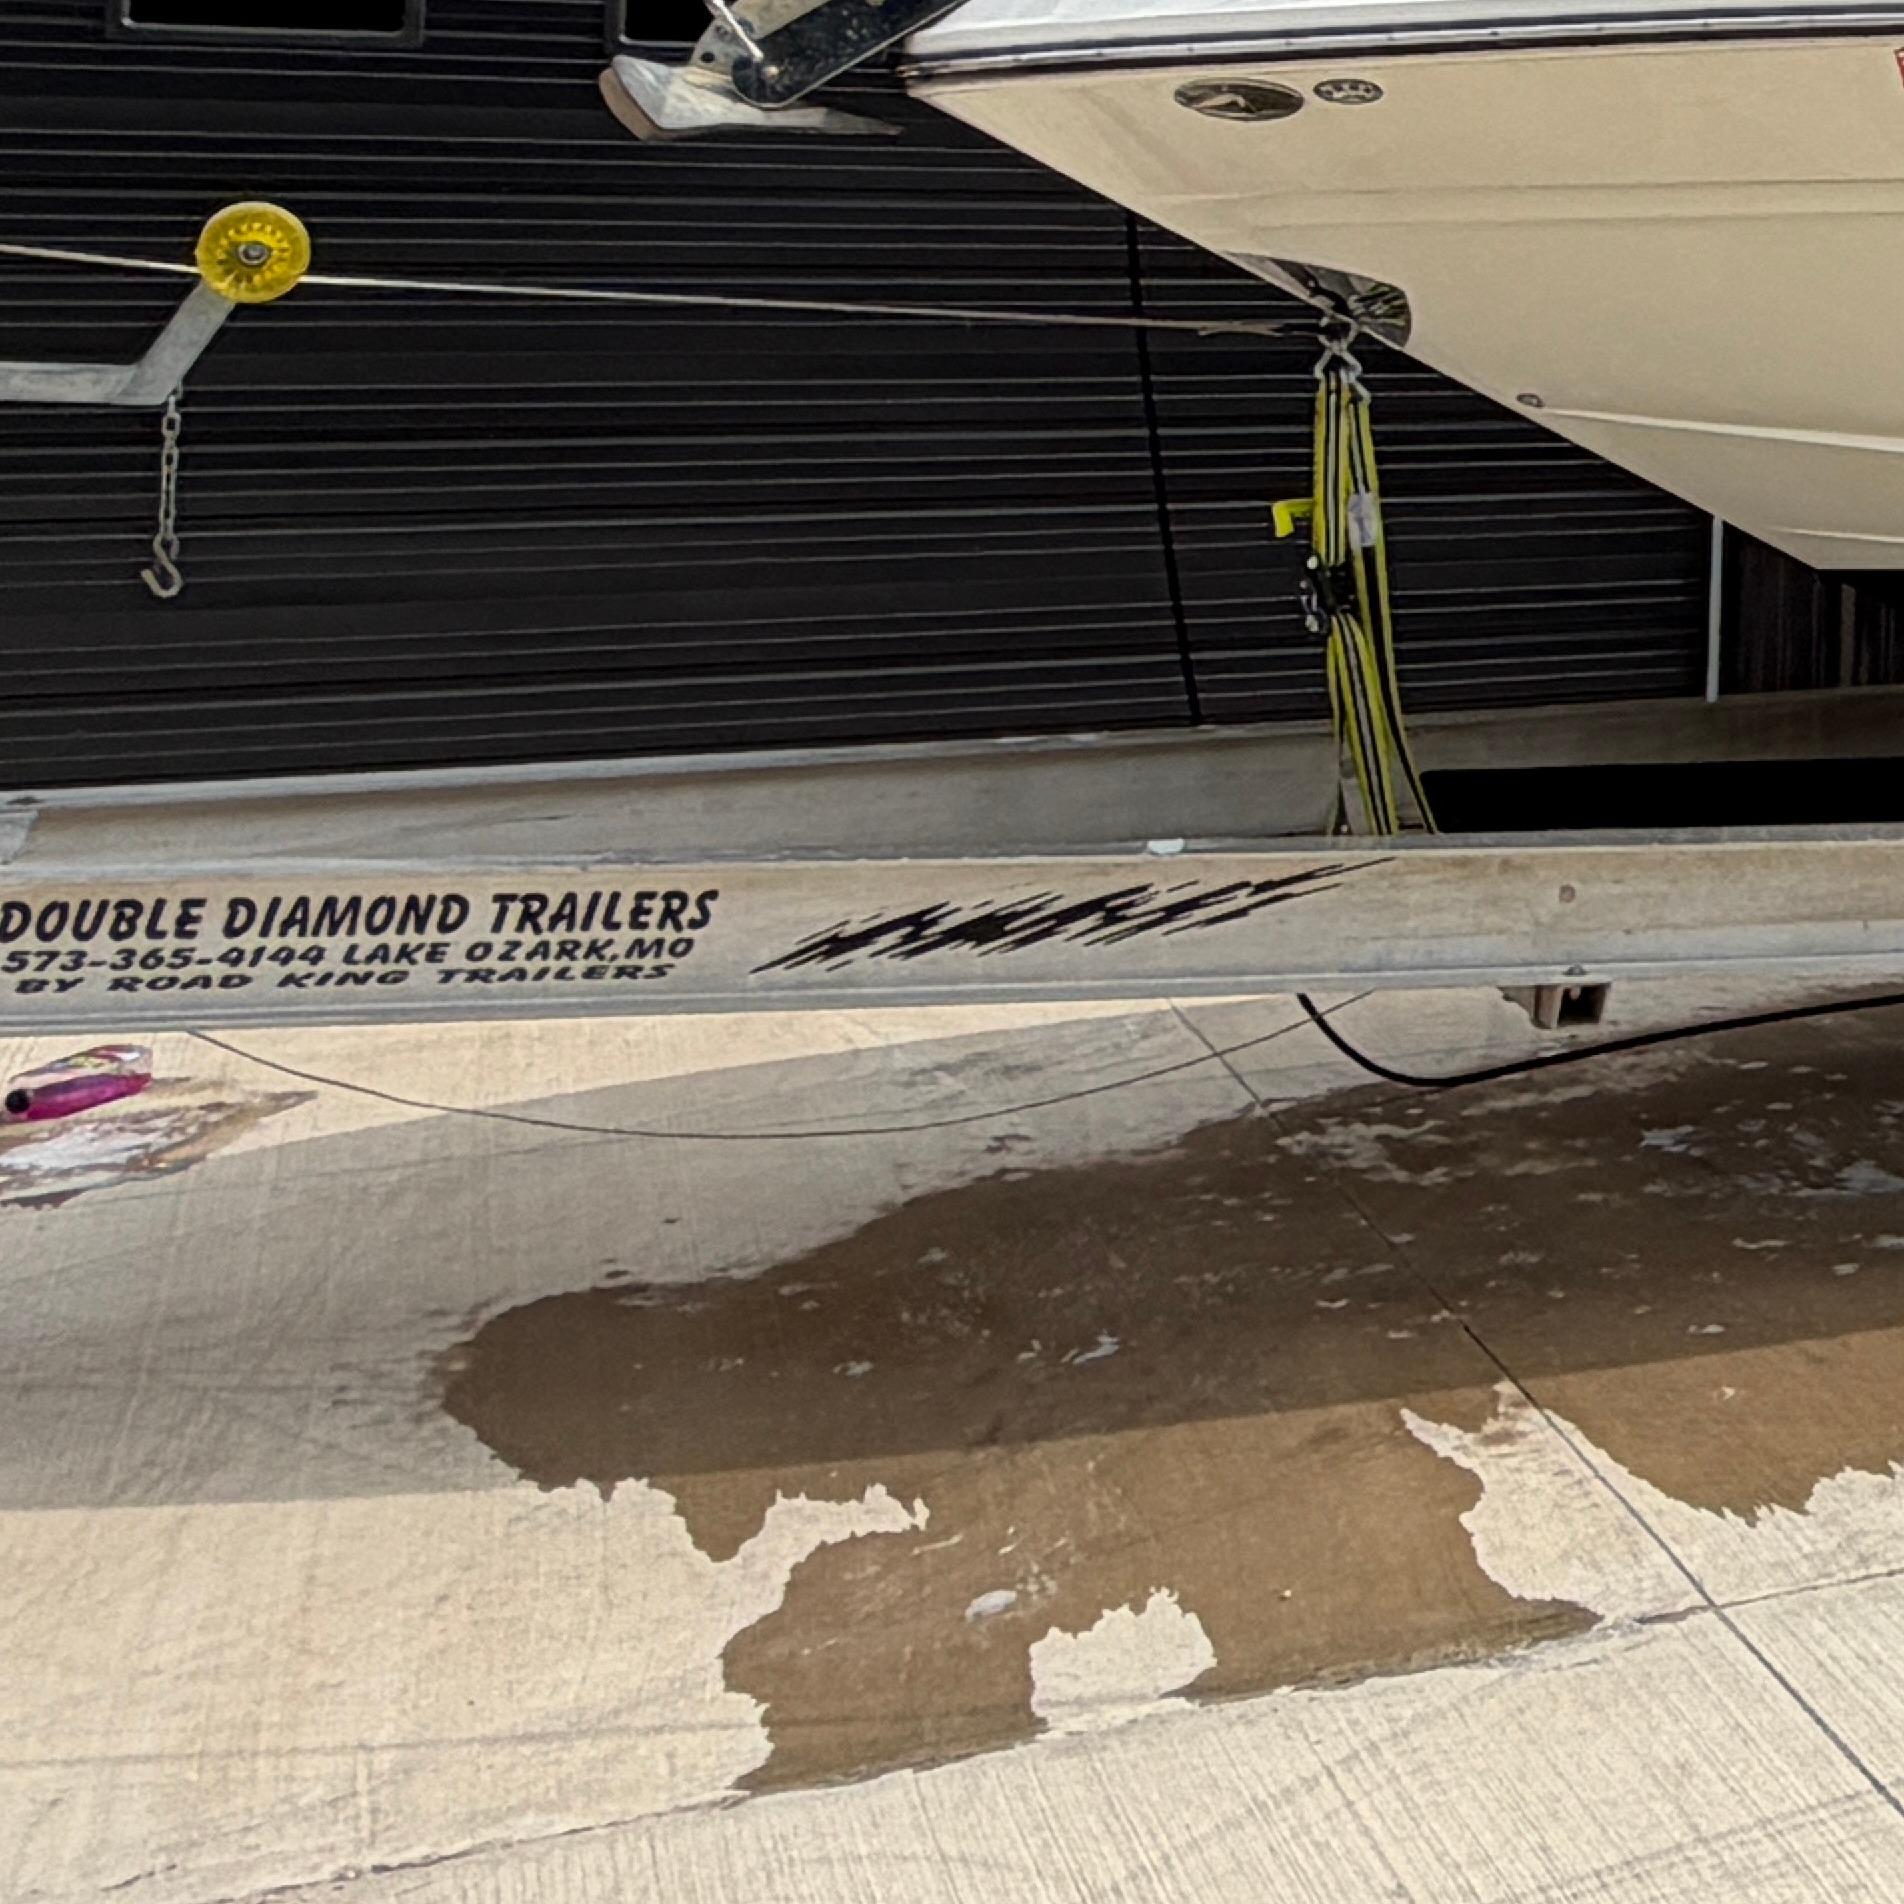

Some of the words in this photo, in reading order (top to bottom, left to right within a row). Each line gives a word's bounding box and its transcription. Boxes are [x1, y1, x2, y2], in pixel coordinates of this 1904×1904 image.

[0, 898, 207, 942] DOUBLE
[223, 895, 470, 937] DIAMOND
[490, 889, 721, 934] TRAILERS
[2, 945, 326, 973] 573-365-4144
[342, 942, 450, 966] LAKE
[15, 976, 85, 993] BY
[107, 973, 254, 992] ROAD
[277, 970, 410, 988] KING
[437, 964, 676, 984] TRAILERS
